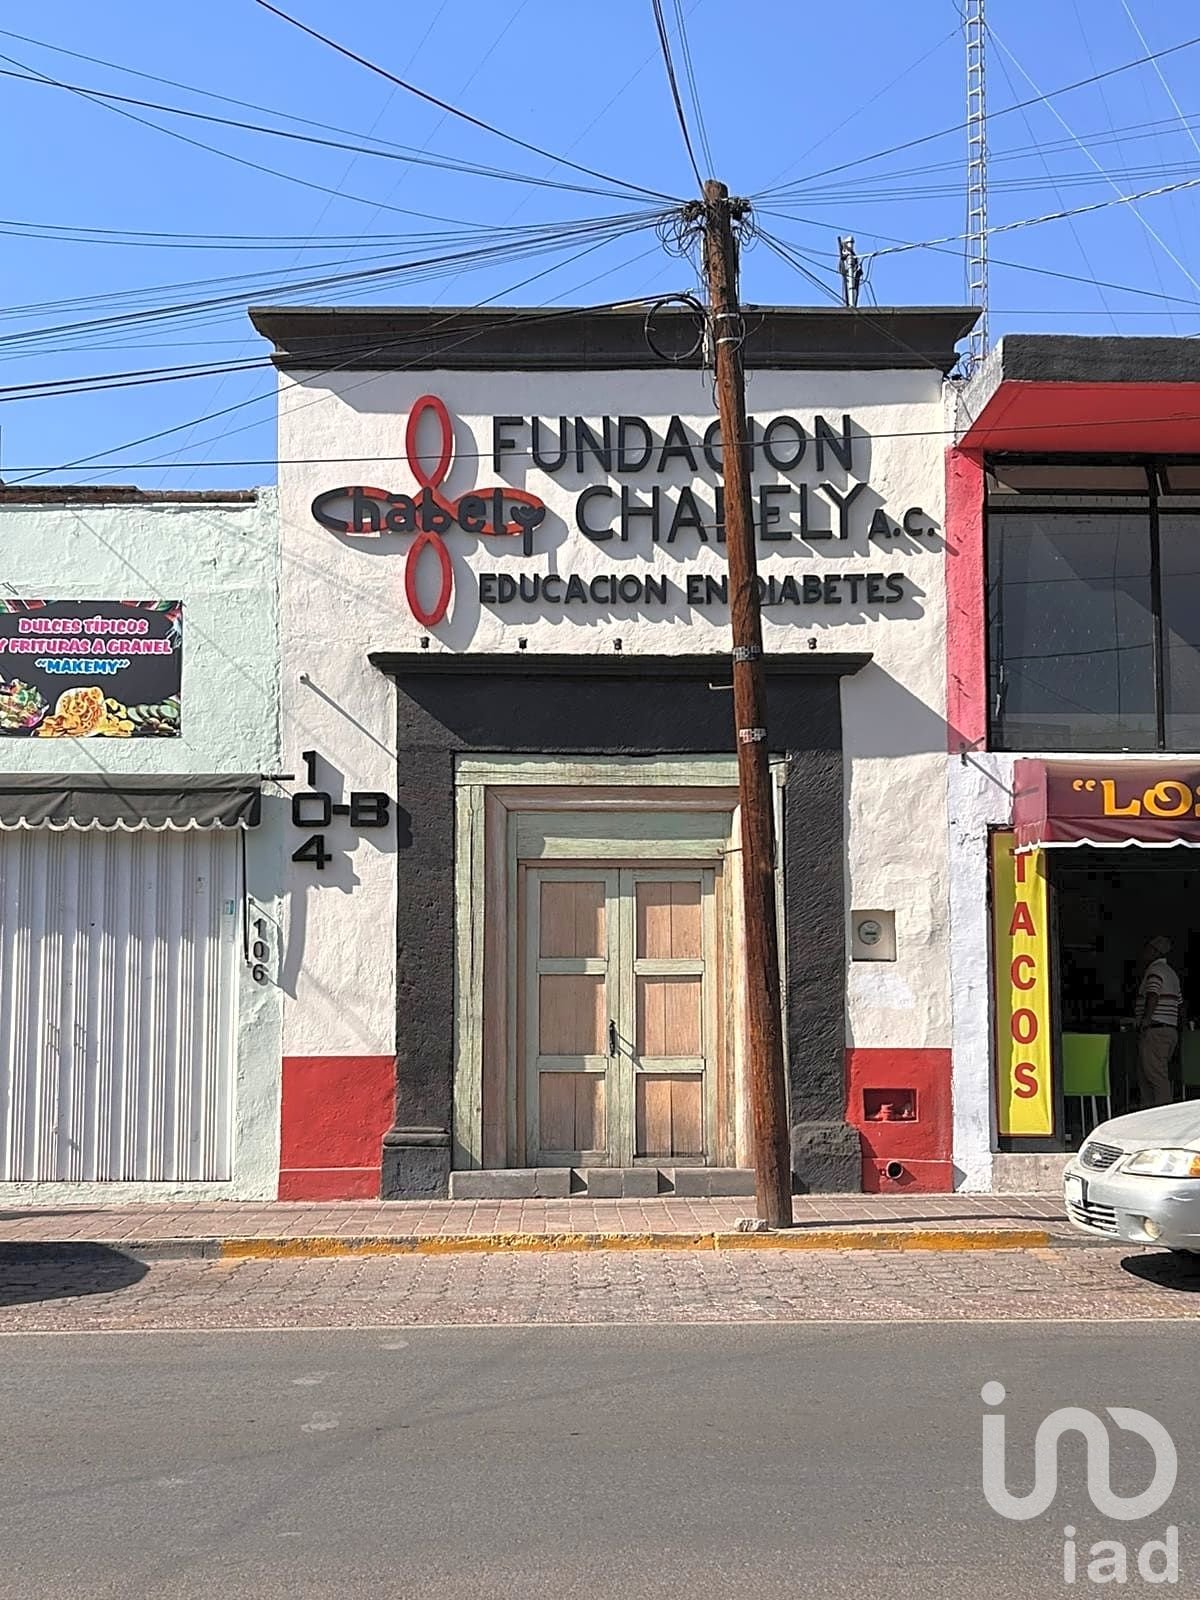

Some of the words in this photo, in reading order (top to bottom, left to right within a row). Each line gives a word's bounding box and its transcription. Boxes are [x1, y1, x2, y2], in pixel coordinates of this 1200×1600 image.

[867, 507, 936, 540] A.C.
[480, 574, 667, 604] EDUCACION
[686, 574, 729, 604] EN
[19, 618, 81, 634] DULCES
[82, 615, 149, 634] TÍPICOS
[9, 639, 91, 654] FRITURAS
[91, 639, 104, 653] A
[107, 640, 173, 654] GRANEL
[1072, 779, 1200, 817] “LO
[253, 918, 267, 982] 106
[1008, 849, 1039, 1099] TACOS
